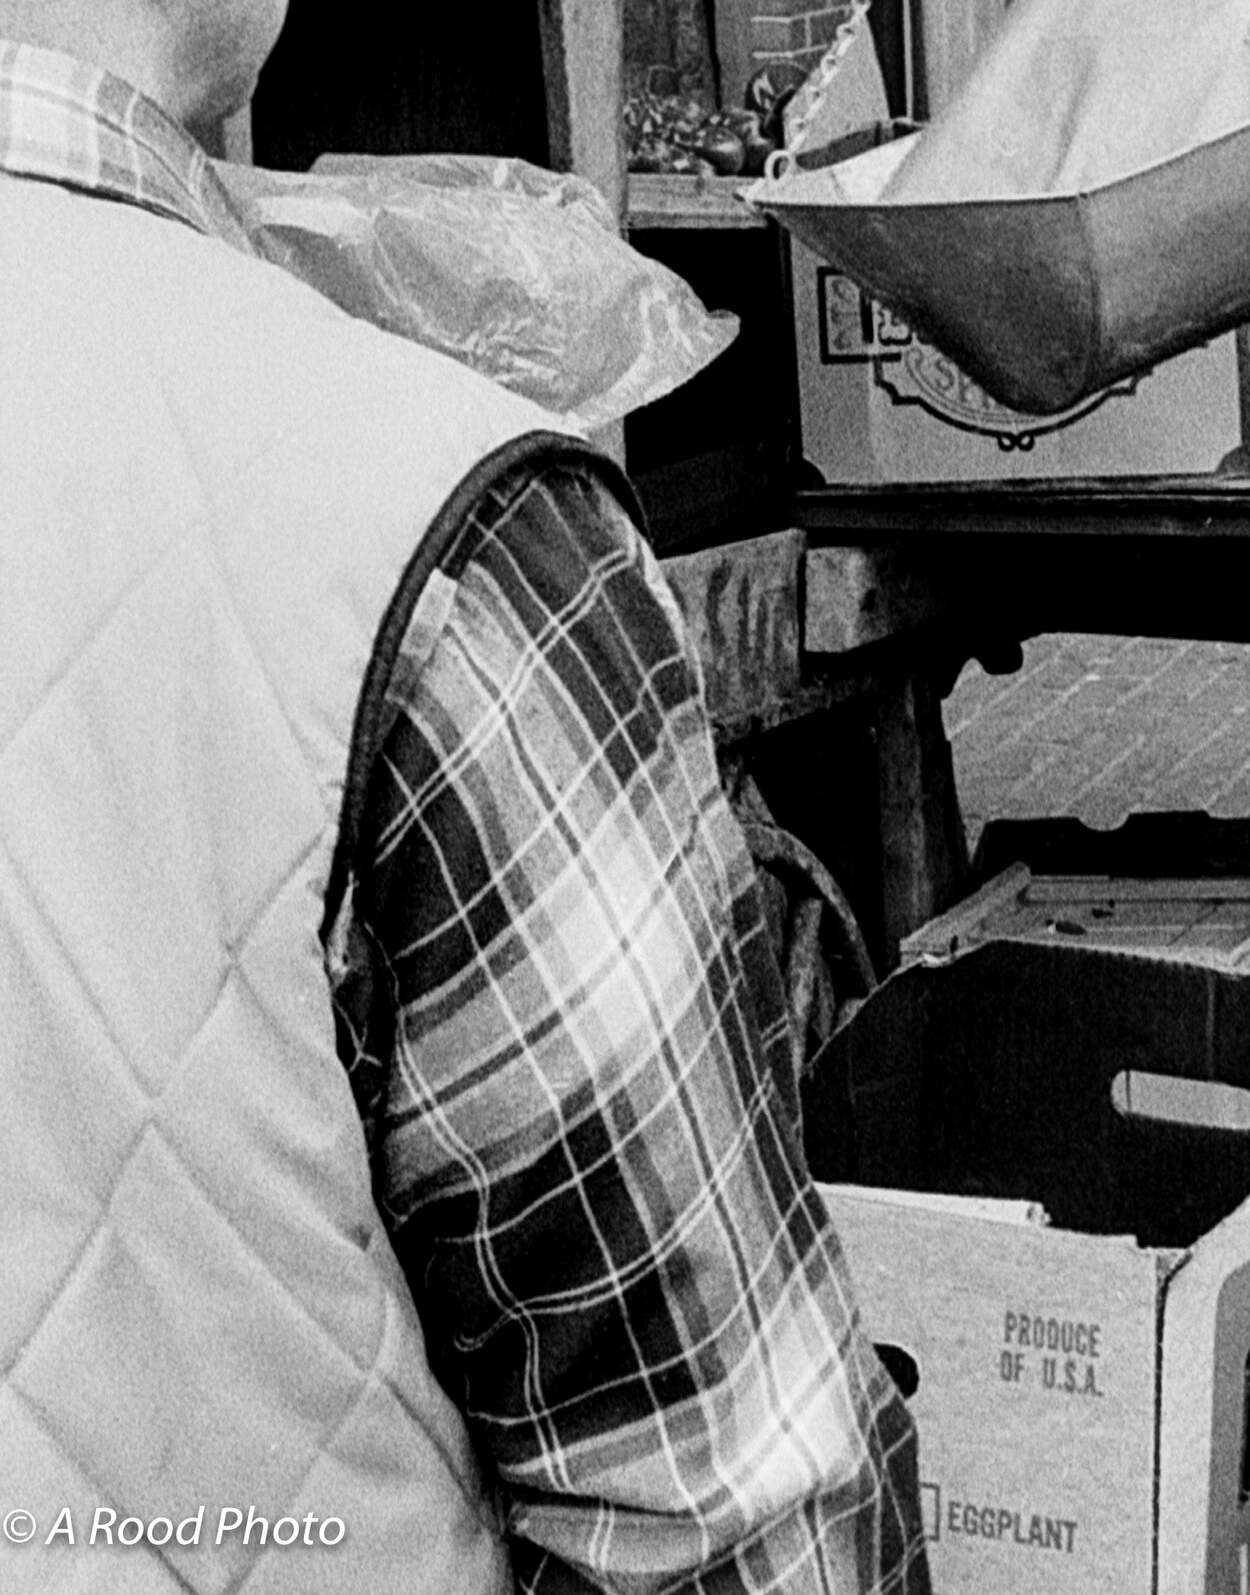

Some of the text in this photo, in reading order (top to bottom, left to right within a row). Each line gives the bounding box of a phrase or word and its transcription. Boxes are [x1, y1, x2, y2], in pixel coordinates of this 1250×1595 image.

[1003, 1310, 1101, 1358] PRODUCE
[1000, 1351, 1103, 1397] OF U.S.A.
[947, 1500, 1078, 1554] EGGPLANT
